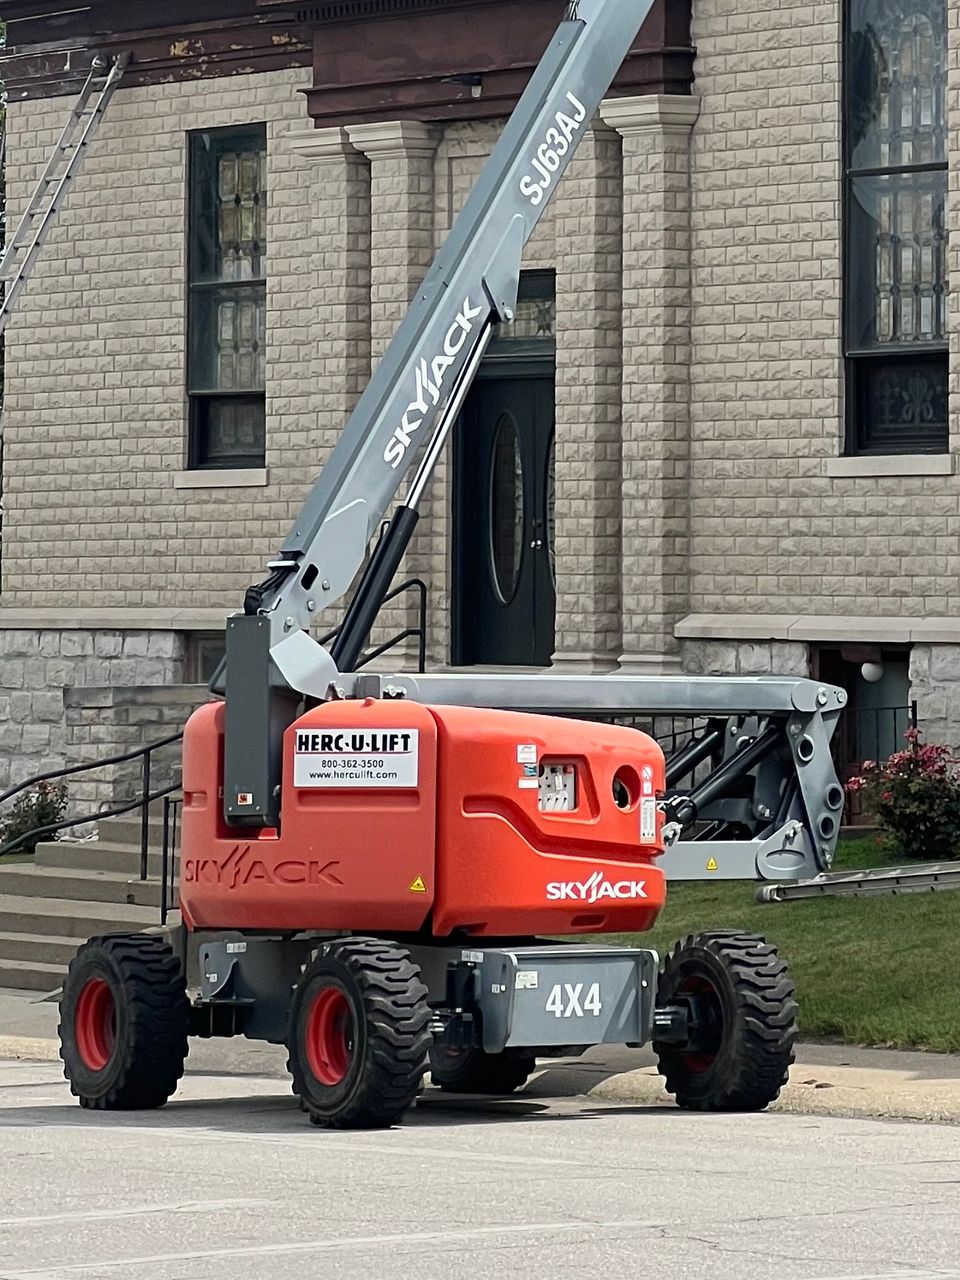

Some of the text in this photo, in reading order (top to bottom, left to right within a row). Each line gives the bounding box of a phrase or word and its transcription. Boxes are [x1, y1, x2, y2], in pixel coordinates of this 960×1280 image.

[519, 91, 587, 206] SJ63AJ
[383, 296, 483, 470] SKYJACK
[309, 770, 398, 779] www.herculift.com
[321, 759, 384, 768] 800-362-3500
[184, 842, 345, 889] SKYJACK
[545, 871, 648, 904] SKYJACK
[545, 982, 602, 1018] 4X4
